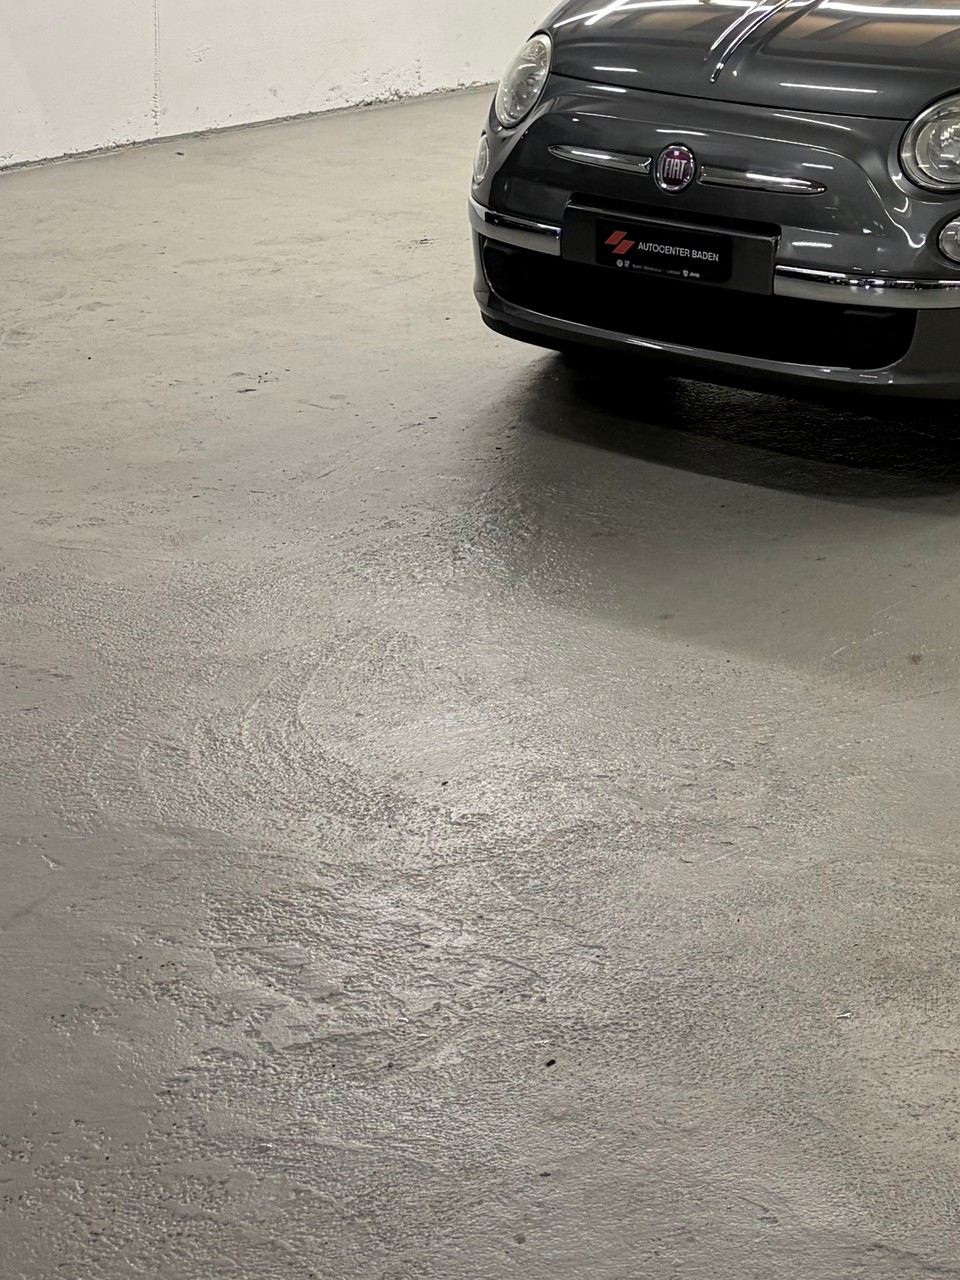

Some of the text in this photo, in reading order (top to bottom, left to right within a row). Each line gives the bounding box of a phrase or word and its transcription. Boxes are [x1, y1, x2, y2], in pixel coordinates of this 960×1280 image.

[663, 158, 688, 180] FIAT
[637, 241, 719, 262] AUTOCENTER BADEN
